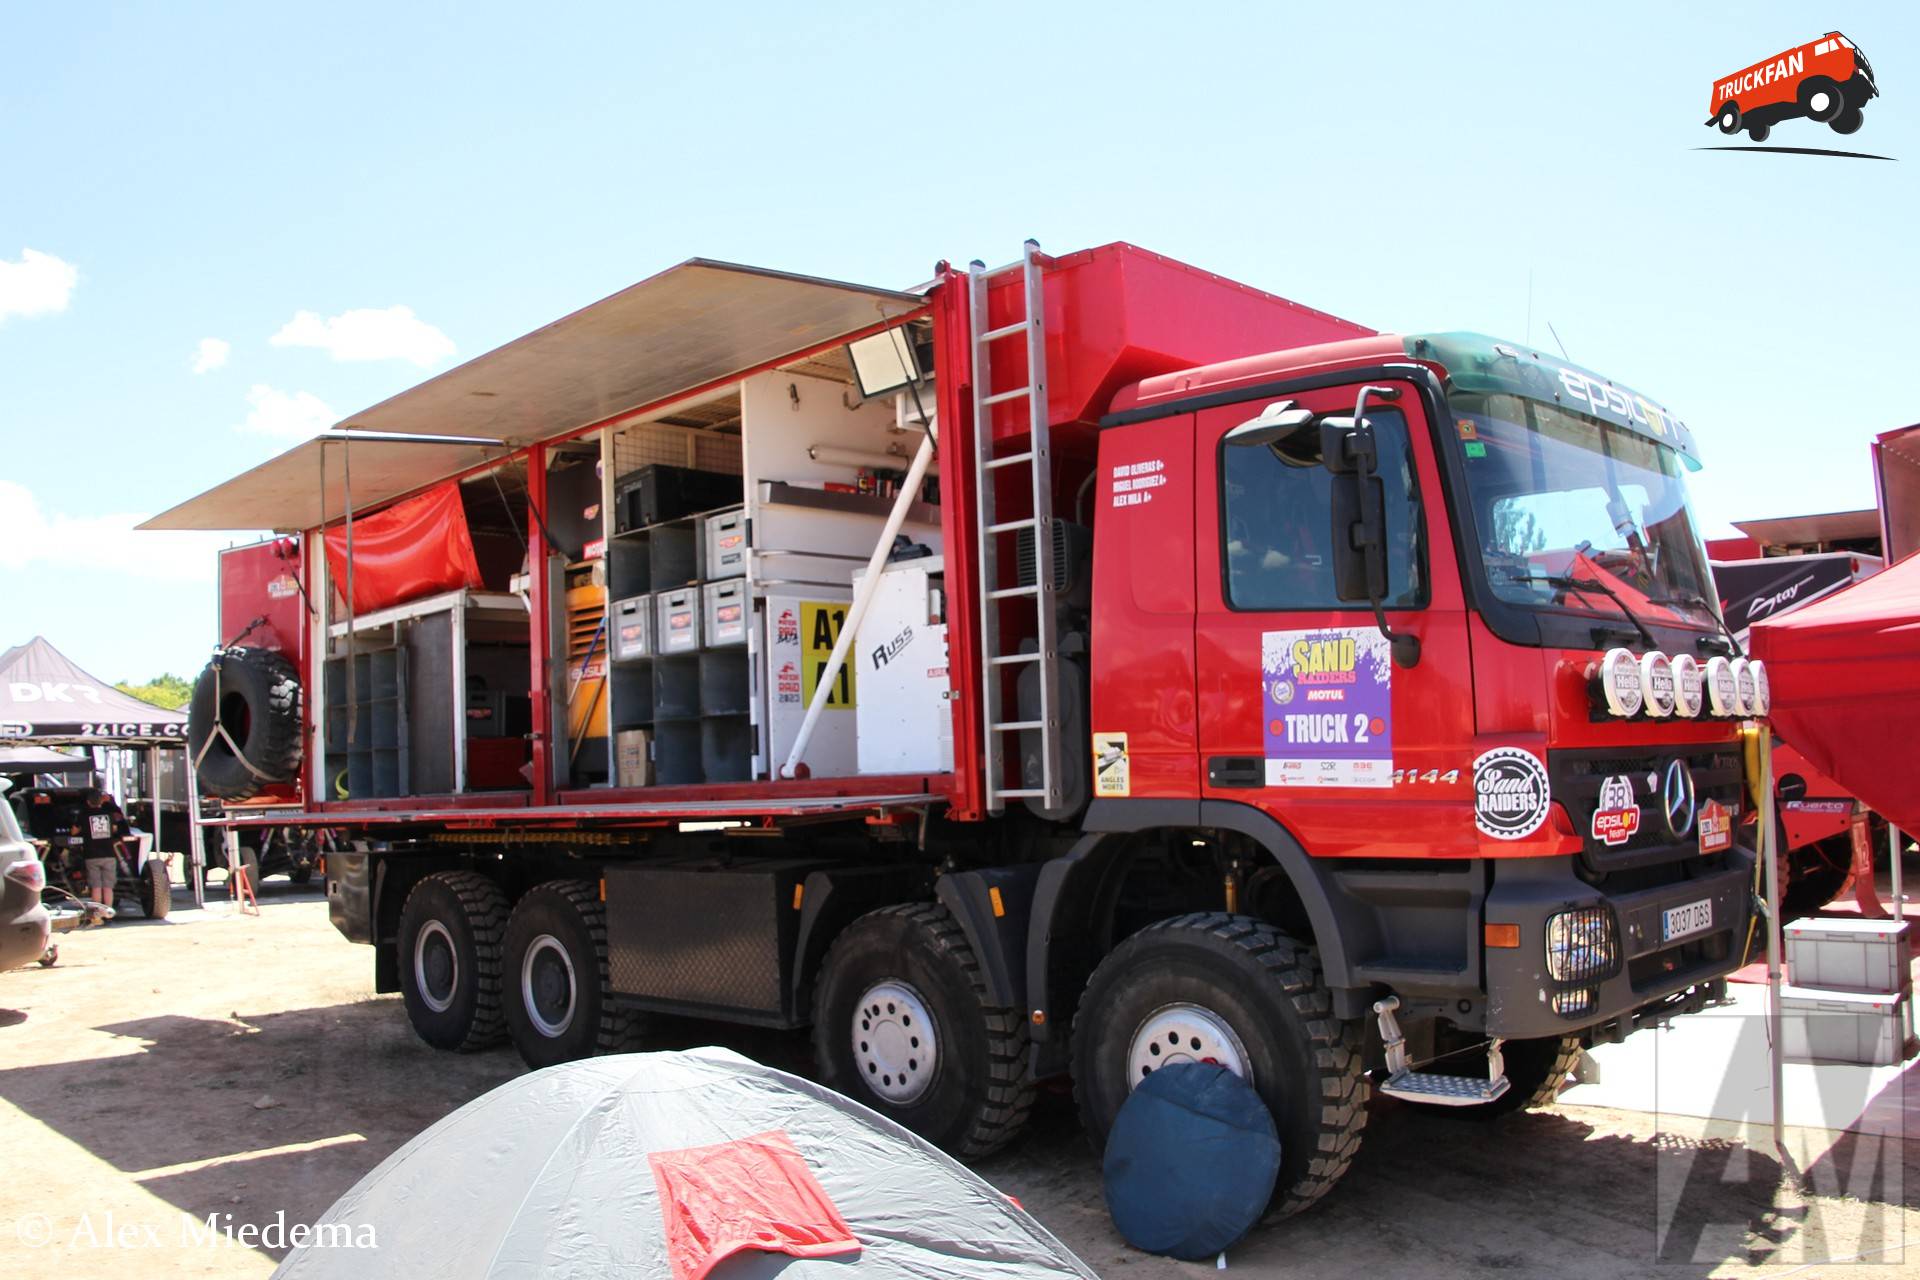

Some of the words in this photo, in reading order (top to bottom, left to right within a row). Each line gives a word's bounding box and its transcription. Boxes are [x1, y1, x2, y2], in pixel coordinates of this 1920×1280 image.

[813, 609, 845, 650] A1
[1293, 638, 1355, 677] SAND
[1298, 671, 1356, 684] RAIDERS
[1653, 676, 1673, 690] Hella
[9, 682, 103, 703] DKR
[1307, 690, 1343, 701] MOTUL
[1285, 713, 1349, 743] TRUCK
[1354, 713, 1369, 743] 2
[1389, 768, 1460, 784] 4144
[1477, 768, 1535, 794] Sand
[1478, 792, 1537, 812] RAIDERS
[1607, 786, 1625, 810] 38
[1596, 811, 1636, 831] epsilon
[1670, 908, 1691, 934] 3037
